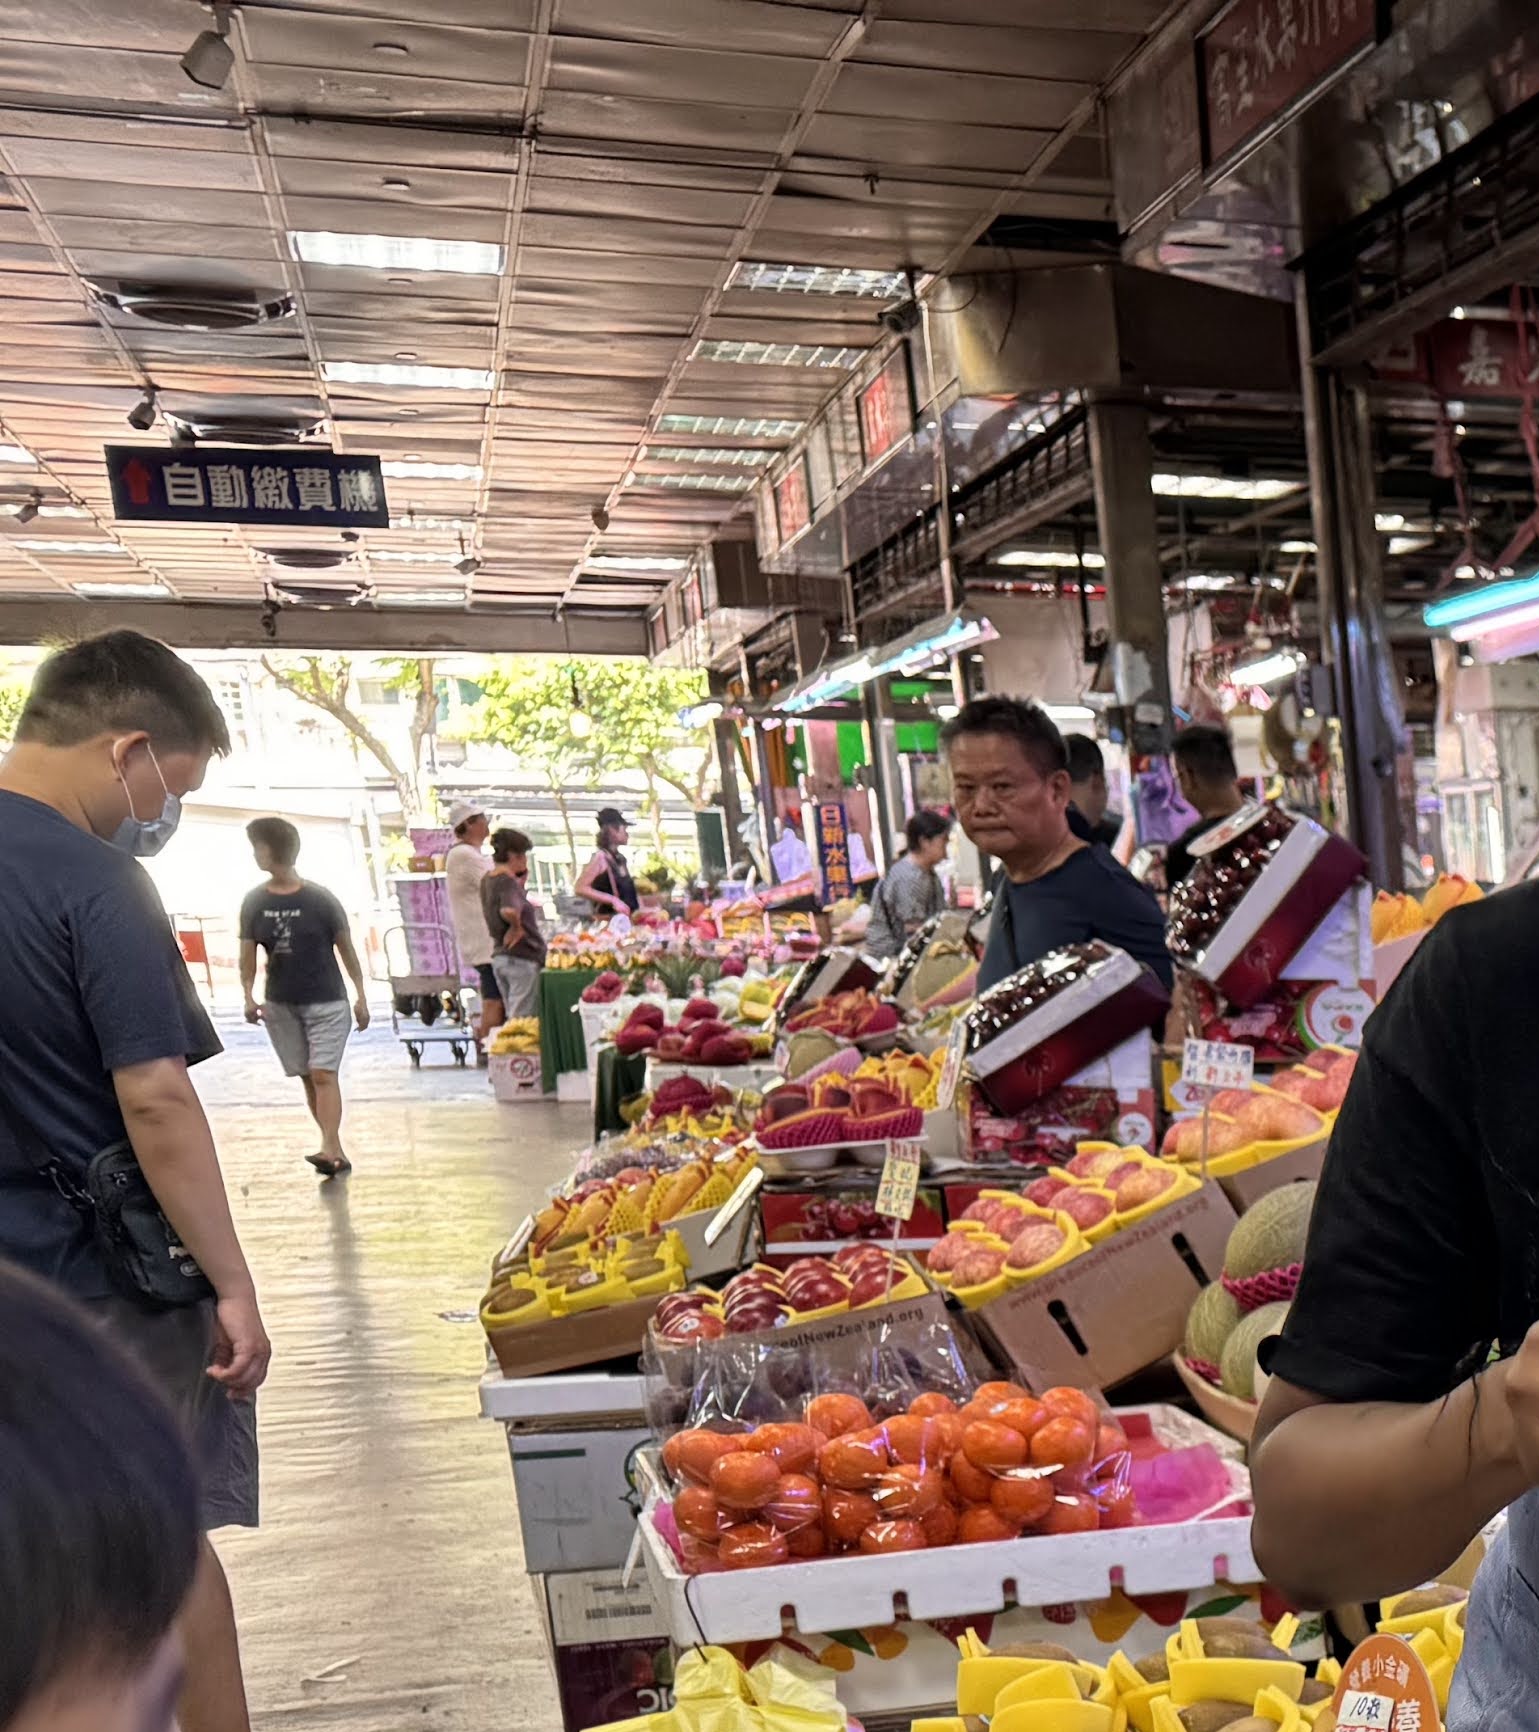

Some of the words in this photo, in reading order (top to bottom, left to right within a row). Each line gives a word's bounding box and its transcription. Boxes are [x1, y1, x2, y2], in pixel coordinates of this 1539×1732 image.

[162, 462, 379, 513] 自動繳費機
